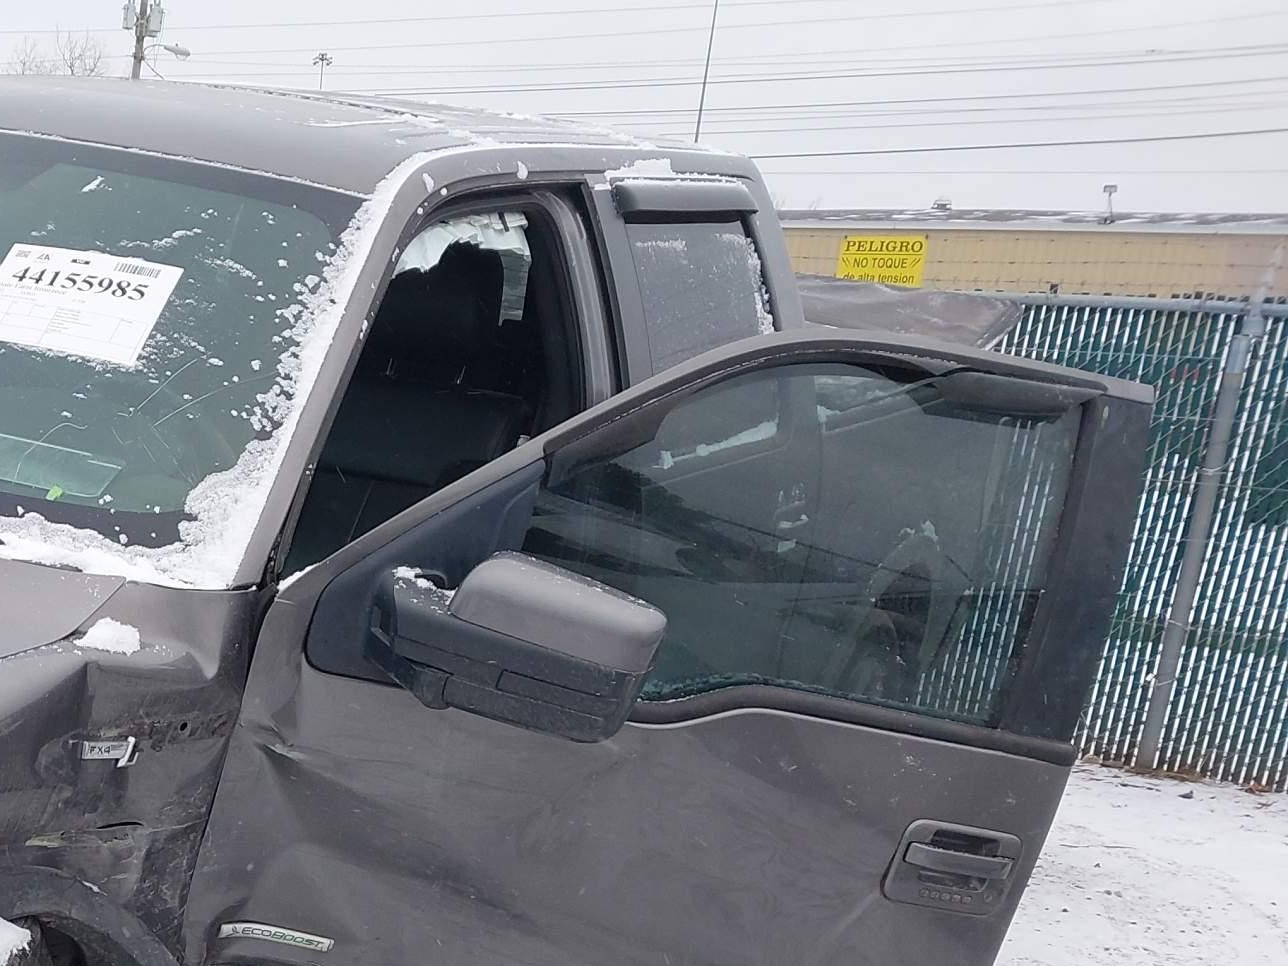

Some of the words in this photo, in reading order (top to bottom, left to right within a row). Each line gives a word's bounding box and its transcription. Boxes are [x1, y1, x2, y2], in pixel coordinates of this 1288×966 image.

[844, 240, 924, 253] PELIGRO
[852, 257, 869, 269] NO
[872, 257, 909, 269] TOQUE
[12, 266, 150, 301] 44155985
[842, 272, 855, 280] de
[857, 272, 875, 281] alta
[878, 272, 915, 284] tension
[89, 746, 111, 755] FX4
[241, 926, 325, 949] ECOBOOST
